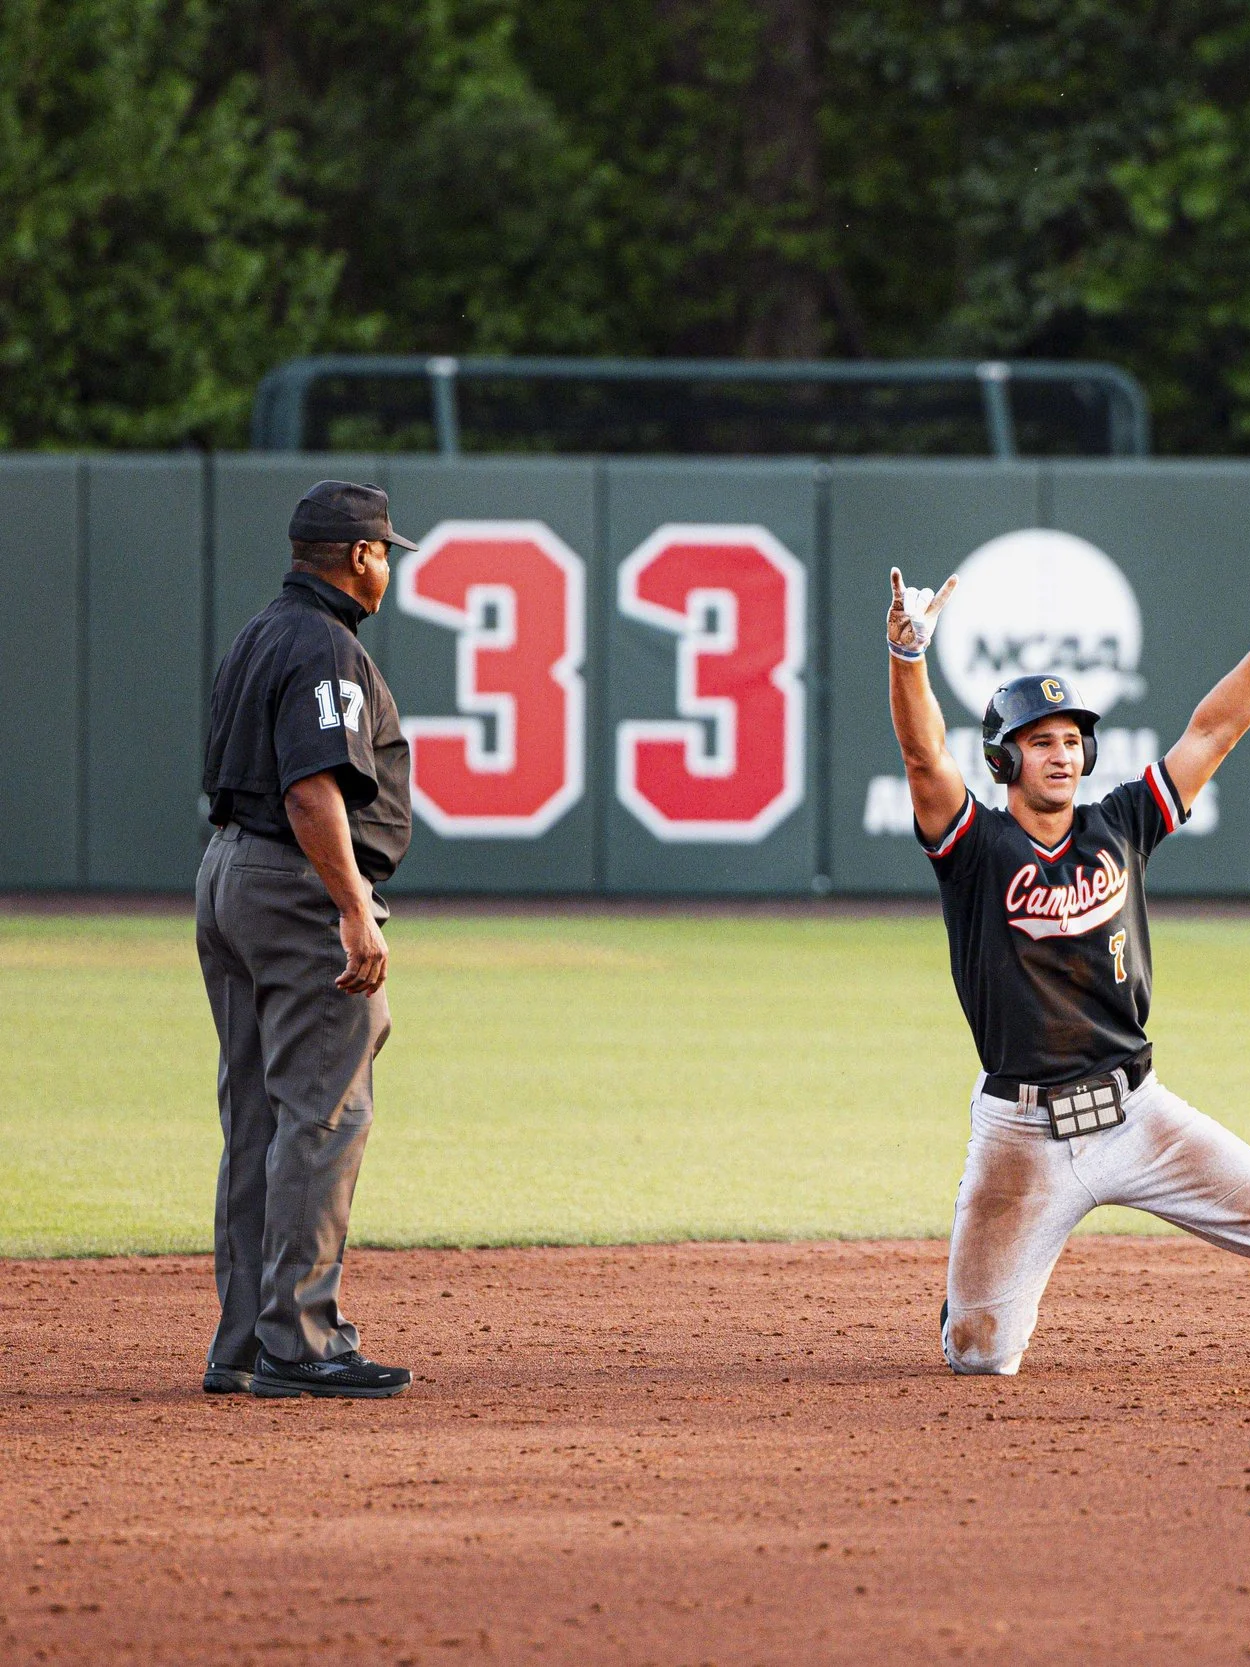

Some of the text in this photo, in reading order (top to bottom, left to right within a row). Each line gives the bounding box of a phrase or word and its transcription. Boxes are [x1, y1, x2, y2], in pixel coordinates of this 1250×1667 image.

[966, 628, 1121, 674] NCAA
[315, 680, 364, 732] 17
[397, 520, 806, 841] 33
[1041, 679, 1065, 703] C
[1006, 849, 1129, 932] Campbell
[1108, 928, 1128, 984] 7
